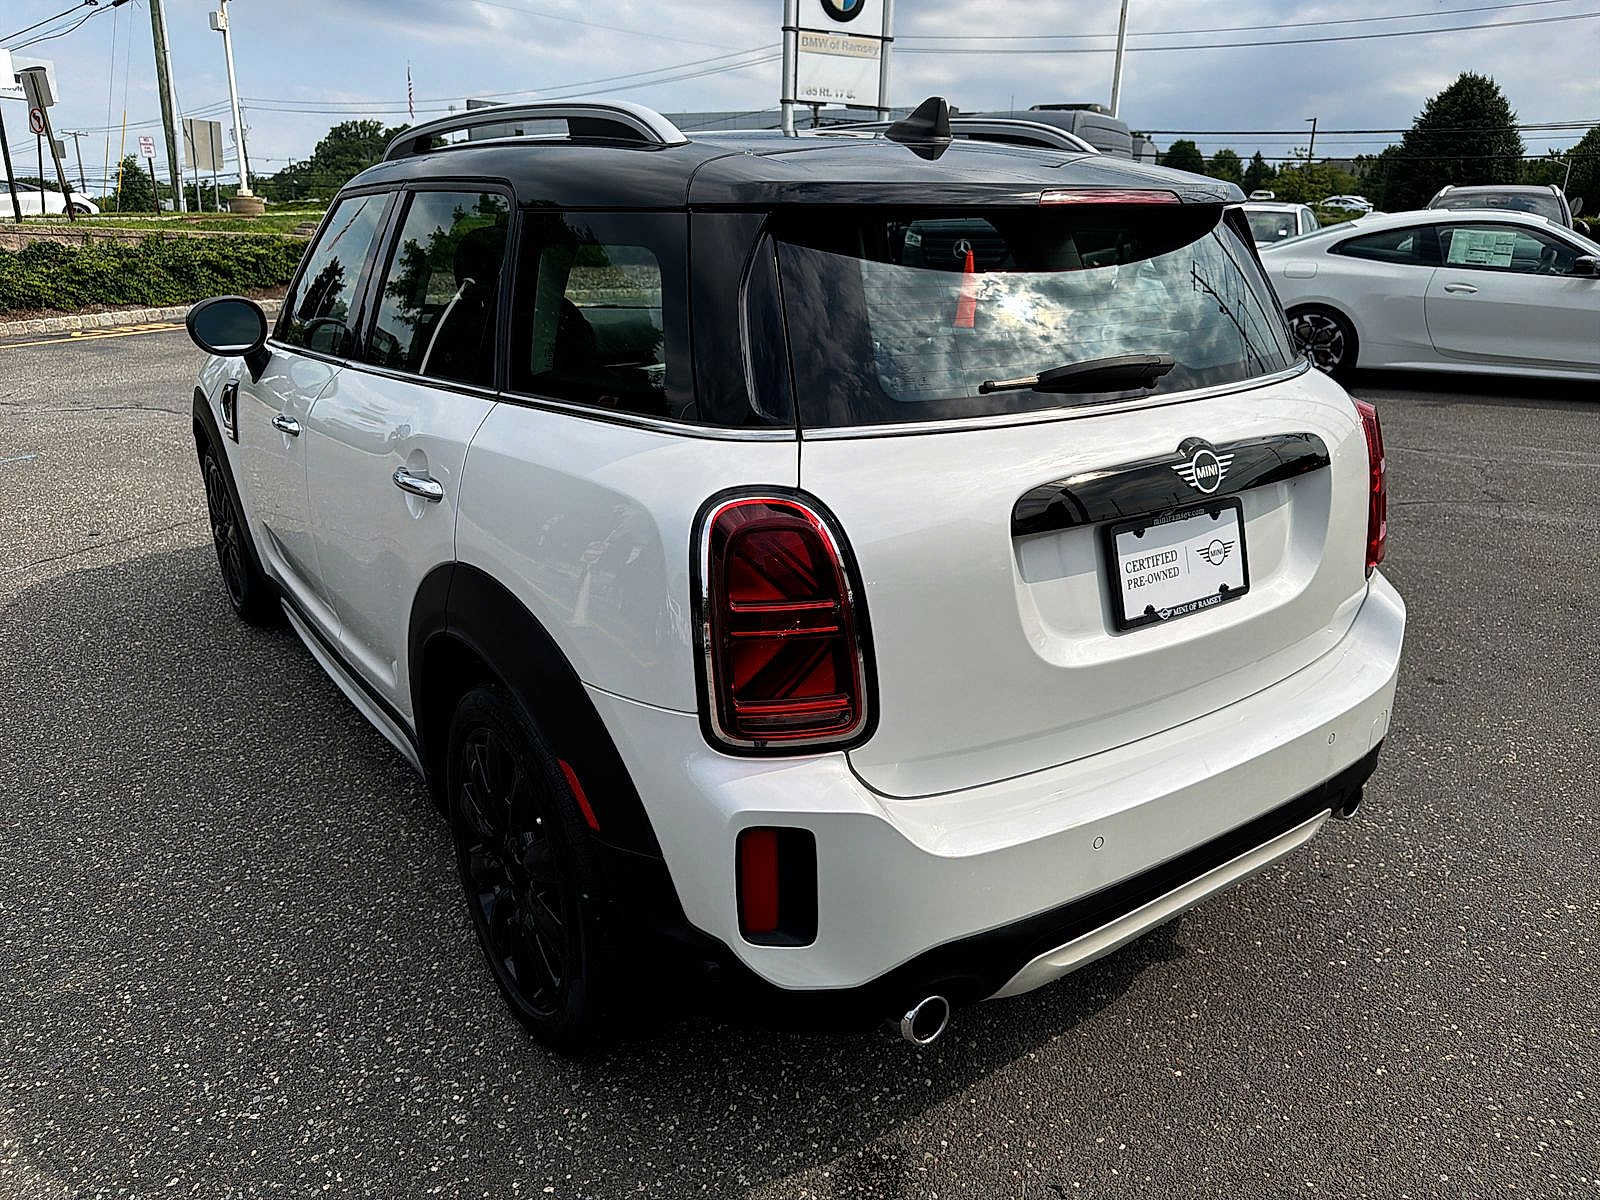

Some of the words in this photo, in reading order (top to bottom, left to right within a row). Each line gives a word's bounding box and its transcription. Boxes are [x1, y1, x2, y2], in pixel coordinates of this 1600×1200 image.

[801, 36, 828, 48] BMW
[829, 39, 840, 50] of
[842, 39, 880, 56] Ramsey
[1196, 463, 1219, 480] MINI
[1153, 508, 1205, 526] miniramsey.com
[1124, 549, 1179, 575] CERTIFIED
[1210, 547, 1223, 558] MINI
[1126, 566, 1180, 591] PRE-OWNED
[1173, 606, 1189, 617] MINI
[1189, 602, 1198, 612] OF
[1198, 595, 1222, 609] RAMSEY
